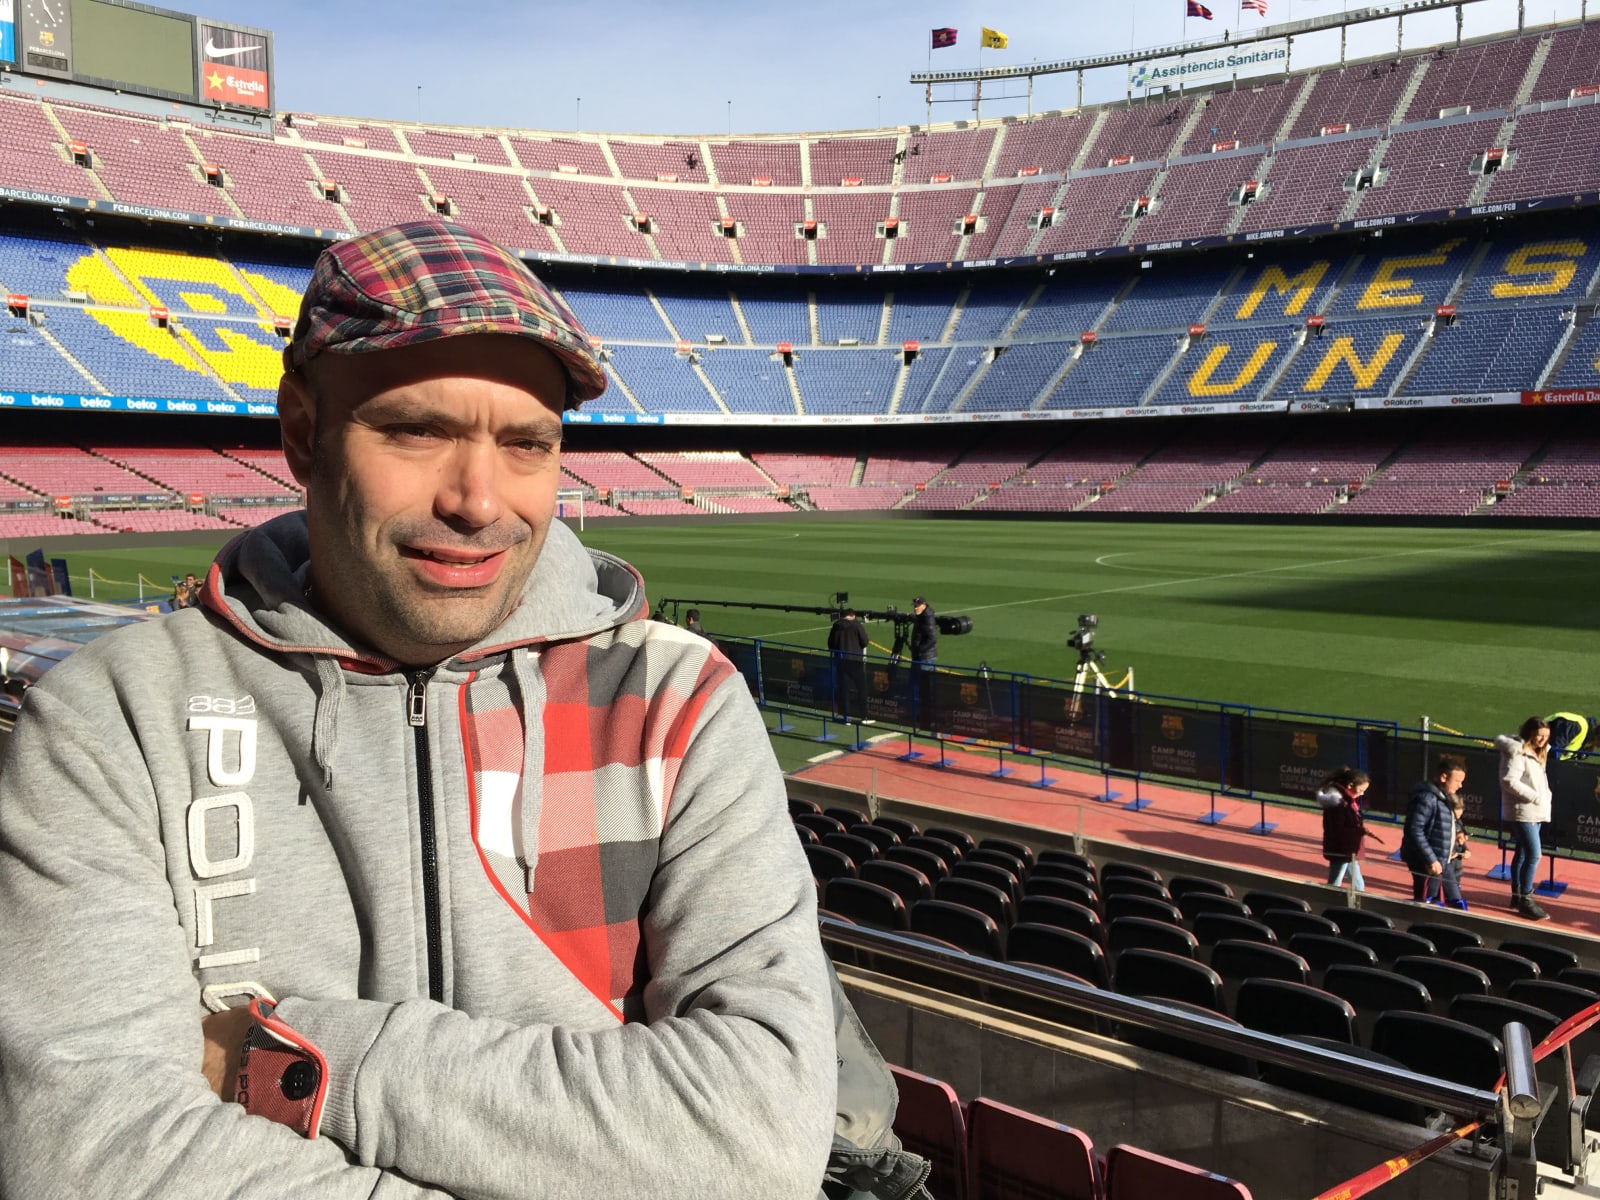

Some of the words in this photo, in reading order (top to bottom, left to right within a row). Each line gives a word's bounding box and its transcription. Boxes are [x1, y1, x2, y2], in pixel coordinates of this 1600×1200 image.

[1152, 59, 1225, 80] Assistència
[1227, 48, 1286, 67] Sanitària
[226, 75, 265, 93] Estrella
[113, 204, 190, 221] FCBARCELONA.COM
[1471, 202, 1516, 215] NIKE.COM/FCB
[228, 219, 300, 234] FCBARCELONA.COM
[1354, 216, 1396, 228] NIKE.COM/FCB
[1246, 229, 1284, 241] NIKE.COM/FCB
[537, 252, 598, 264] FCBARCELONA.COM
[1391, 399, 1423, 407] Rakuten
[1459, 395, 1493, 405] Rakuten
[1544, 391, 1584, 403] Estrella
[31, 395, 64, 407] beko
[80, 396, 111, 409] beko
[126, 398, 157, 410] beko
[167, 400, 197, 412] beko
[207, 401, 236, 413] beko
[248, 403, 275, 414] beko
[1187, 405, 1215, 414] Rakuten
[1245, 403, 1275, 412] Rakuten
[569, 413, 592, 423] beko
[603, 414, 626, 423] beko
[636, 414, 659, 424] beko
[1151, 745, 1175, 754] CAMP
[1177, 749, 1195, 758] NOU
[1280, 764, 1308, 775] CAMP
